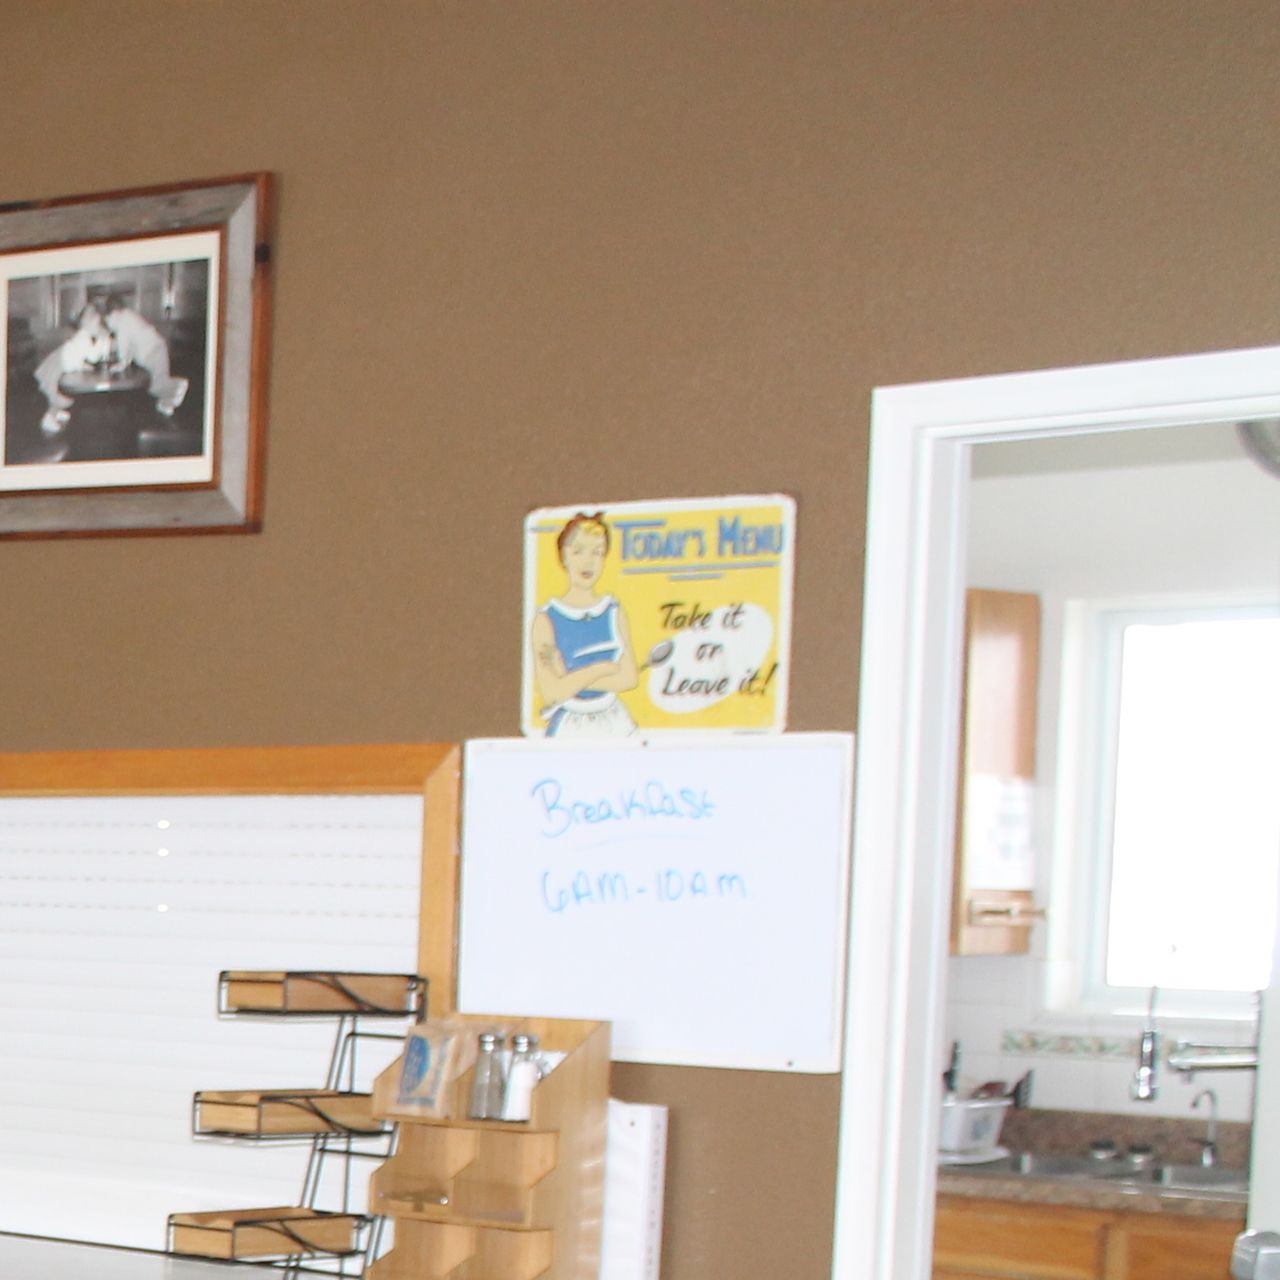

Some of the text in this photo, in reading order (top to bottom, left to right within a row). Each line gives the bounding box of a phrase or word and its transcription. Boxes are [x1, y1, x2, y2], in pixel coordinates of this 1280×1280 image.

[717, 515, 784, 556] MENU
[659, 602, 745, 629] Take it
[696, 643, 723, 660] or
[662, 662, 778, 695] Leave it!
